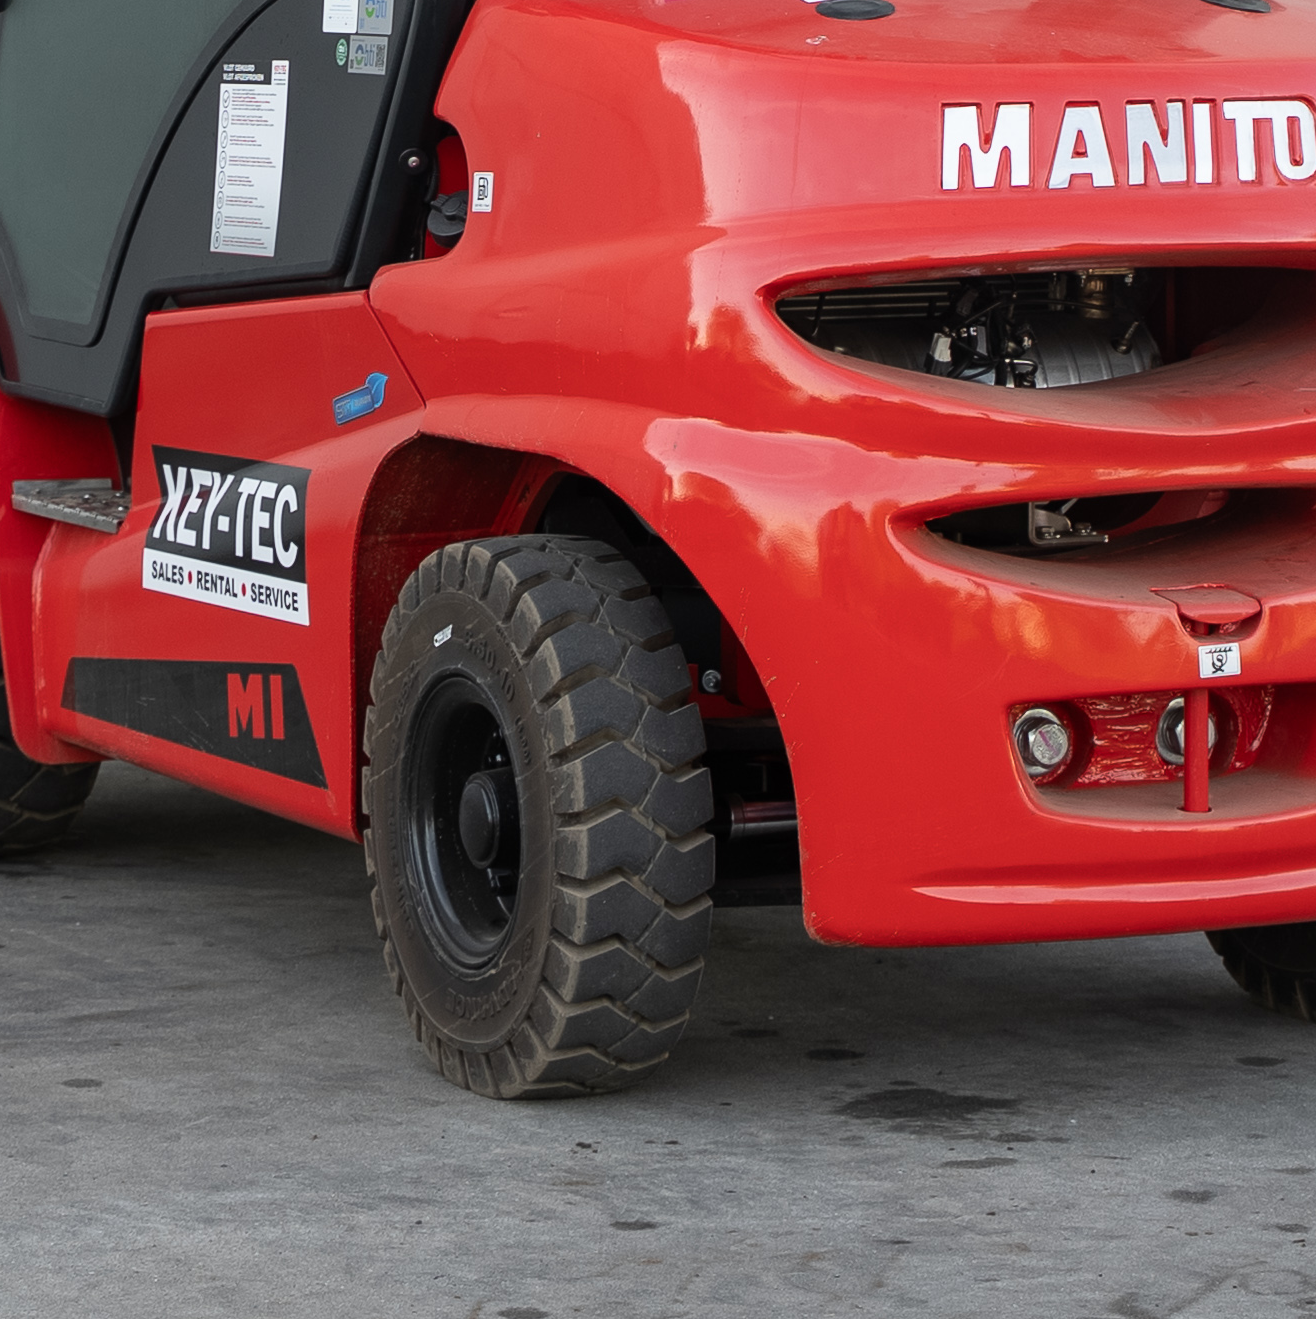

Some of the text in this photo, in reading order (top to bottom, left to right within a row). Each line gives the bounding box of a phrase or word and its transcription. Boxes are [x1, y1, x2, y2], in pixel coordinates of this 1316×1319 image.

[152, 463, 299, 569] KEY-TEC
[151, 560, 299, 612] SALES RENTAL SERVICE
[226, 672, 285, 740] MI
